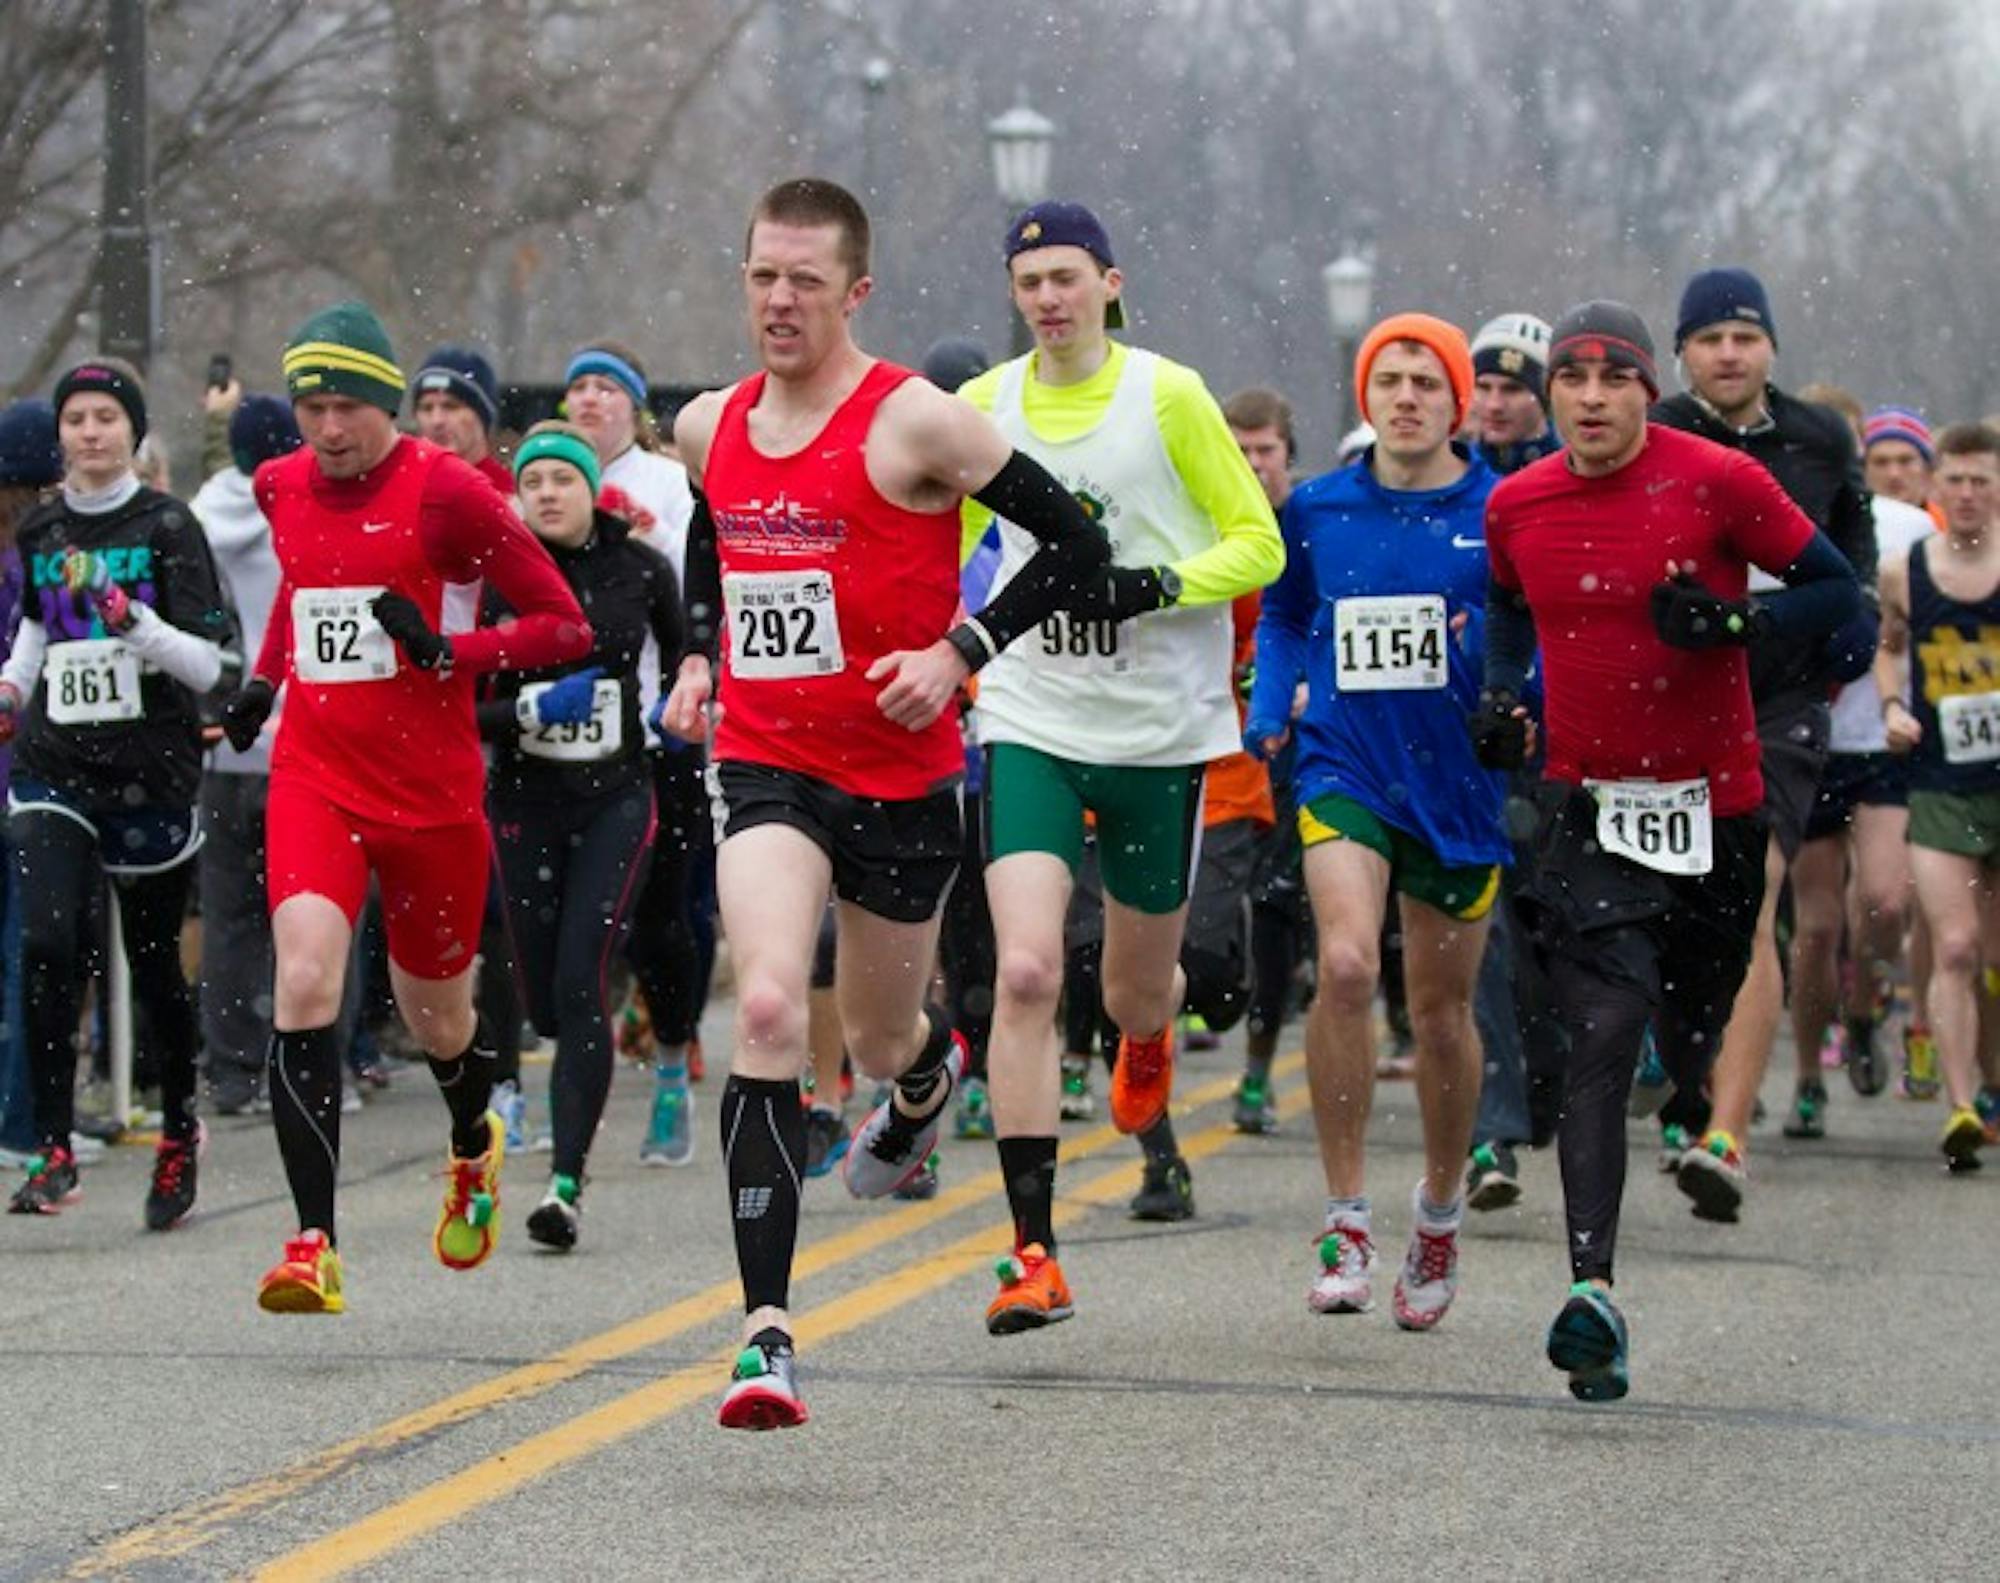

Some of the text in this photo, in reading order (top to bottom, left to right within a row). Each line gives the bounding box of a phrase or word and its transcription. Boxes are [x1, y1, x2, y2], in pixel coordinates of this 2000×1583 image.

[317, 620, 362, 663] 62
[740, 606, 820, 657] 292
[1041, 615, 1118, 657] 980
[1341, 628, 1442, 671] 1154
[61, 667, 123, 706] 861
[1610, 811, 1692, 855] 160
